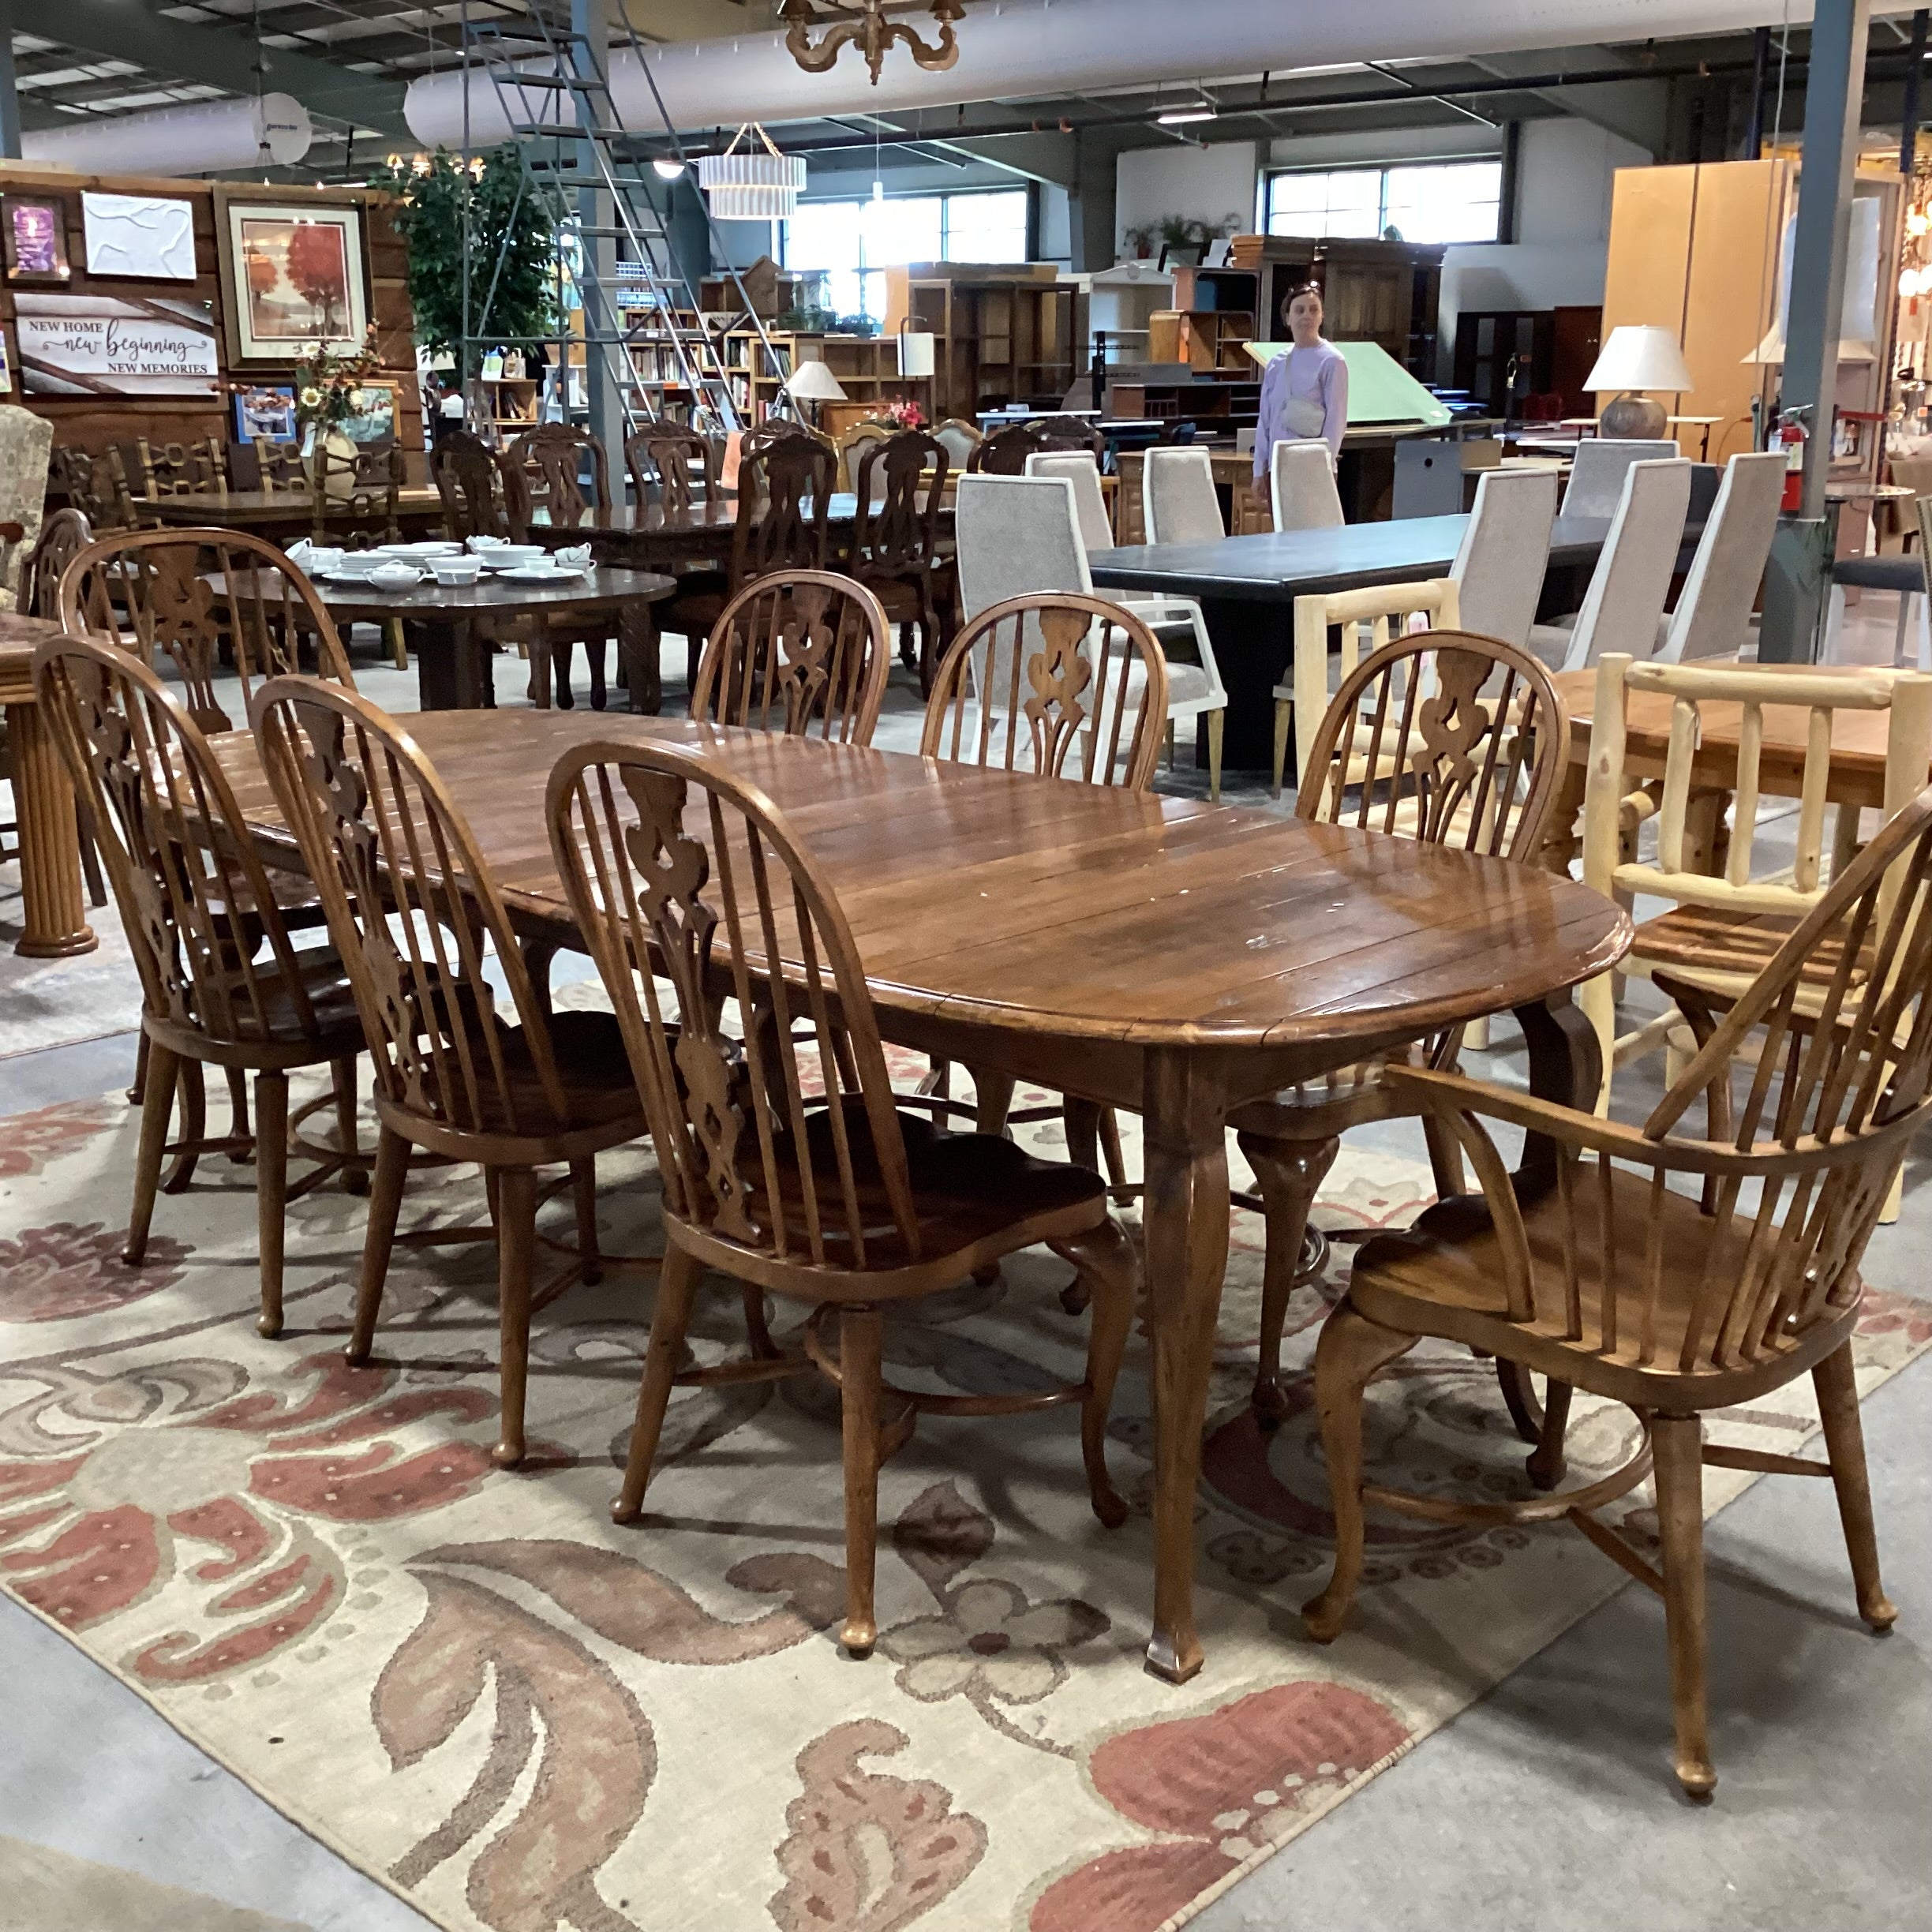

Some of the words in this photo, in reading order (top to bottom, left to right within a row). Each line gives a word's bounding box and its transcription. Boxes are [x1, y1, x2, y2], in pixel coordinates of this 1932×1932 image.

[29, 320, 60, 331] NEW
[64, 322, 103, 333] HOME
[43, 337, 101, 354] new
[107, 318, 207, 361] beginning
[107, 363, 139, 373] NEW
[141, 364, 208, 374] MEMORIES
